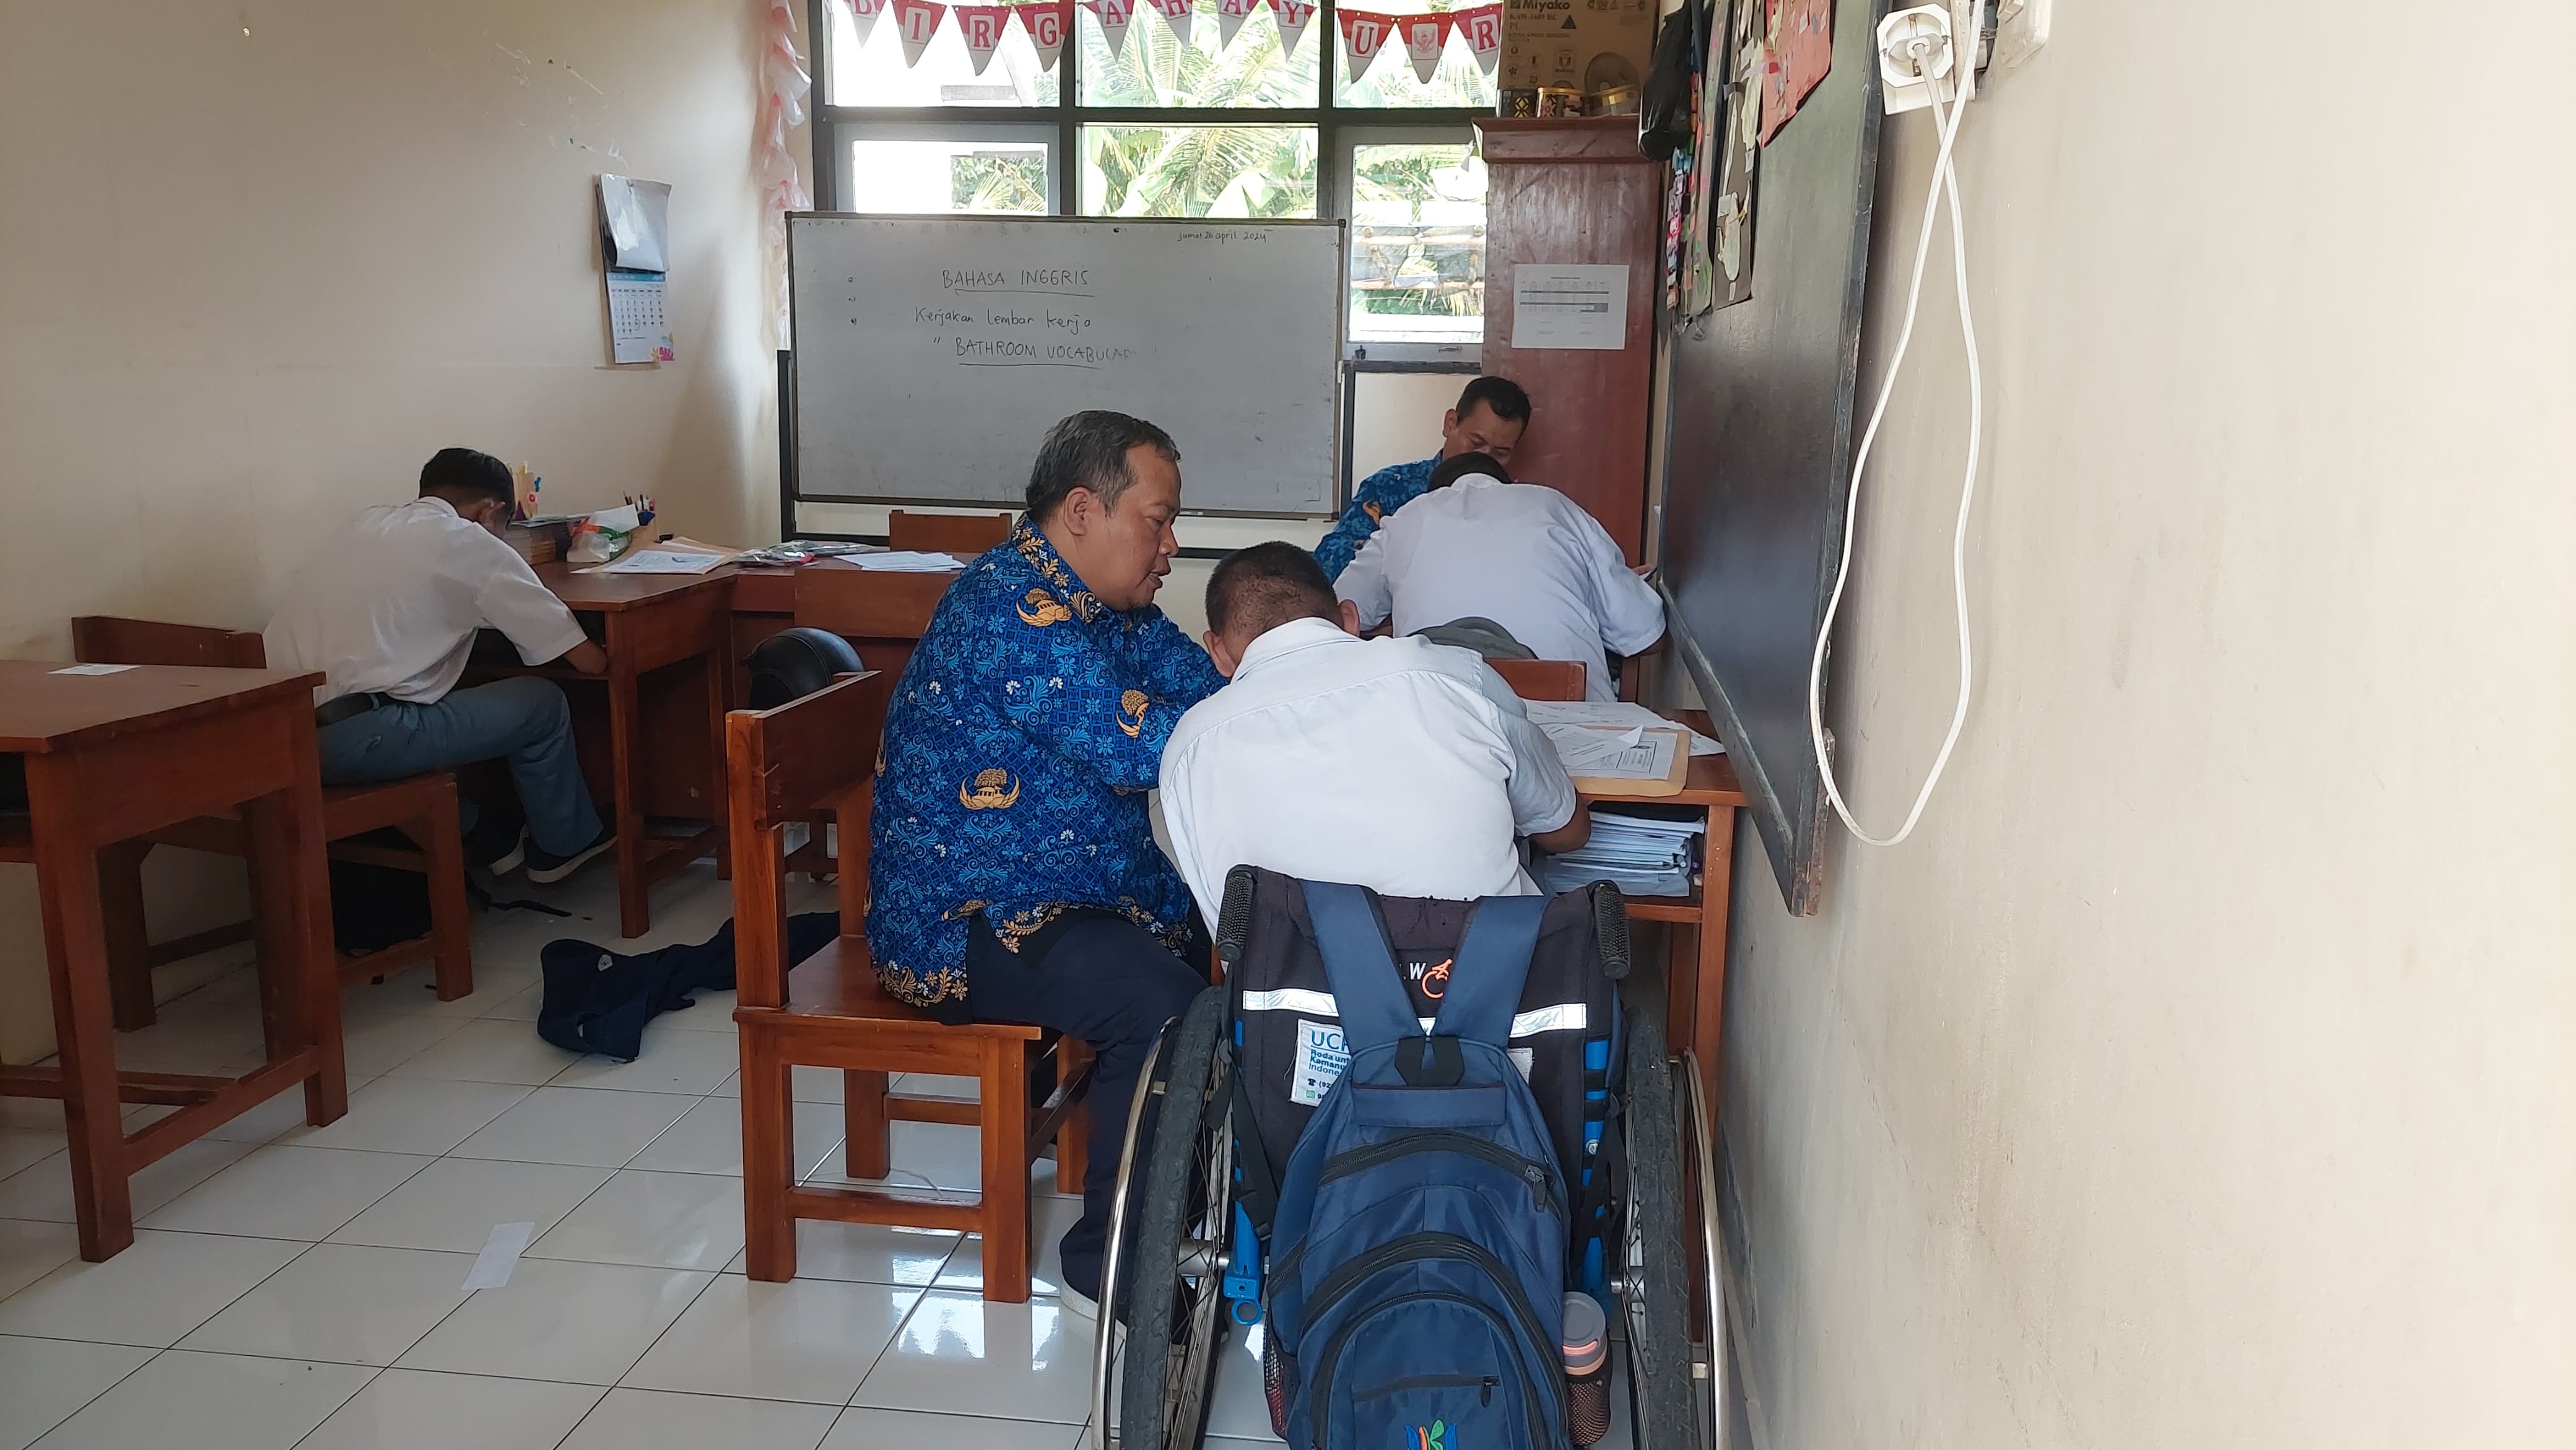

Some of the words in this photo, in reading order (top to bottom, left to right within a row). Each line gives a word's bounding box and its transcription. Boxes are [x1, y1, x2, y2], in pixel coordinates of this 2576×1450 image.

[1523, 0, 1570, 12] Miyako
[1243, 232, 1267, 243] 2024
[942, 269, 1004, 289] BAHASA
[1021, 269, 1089, 285] INGGRIS
[915, 306, 973, 326] Kerjakan
[1310, 1049, 1333, 1060] Roda
